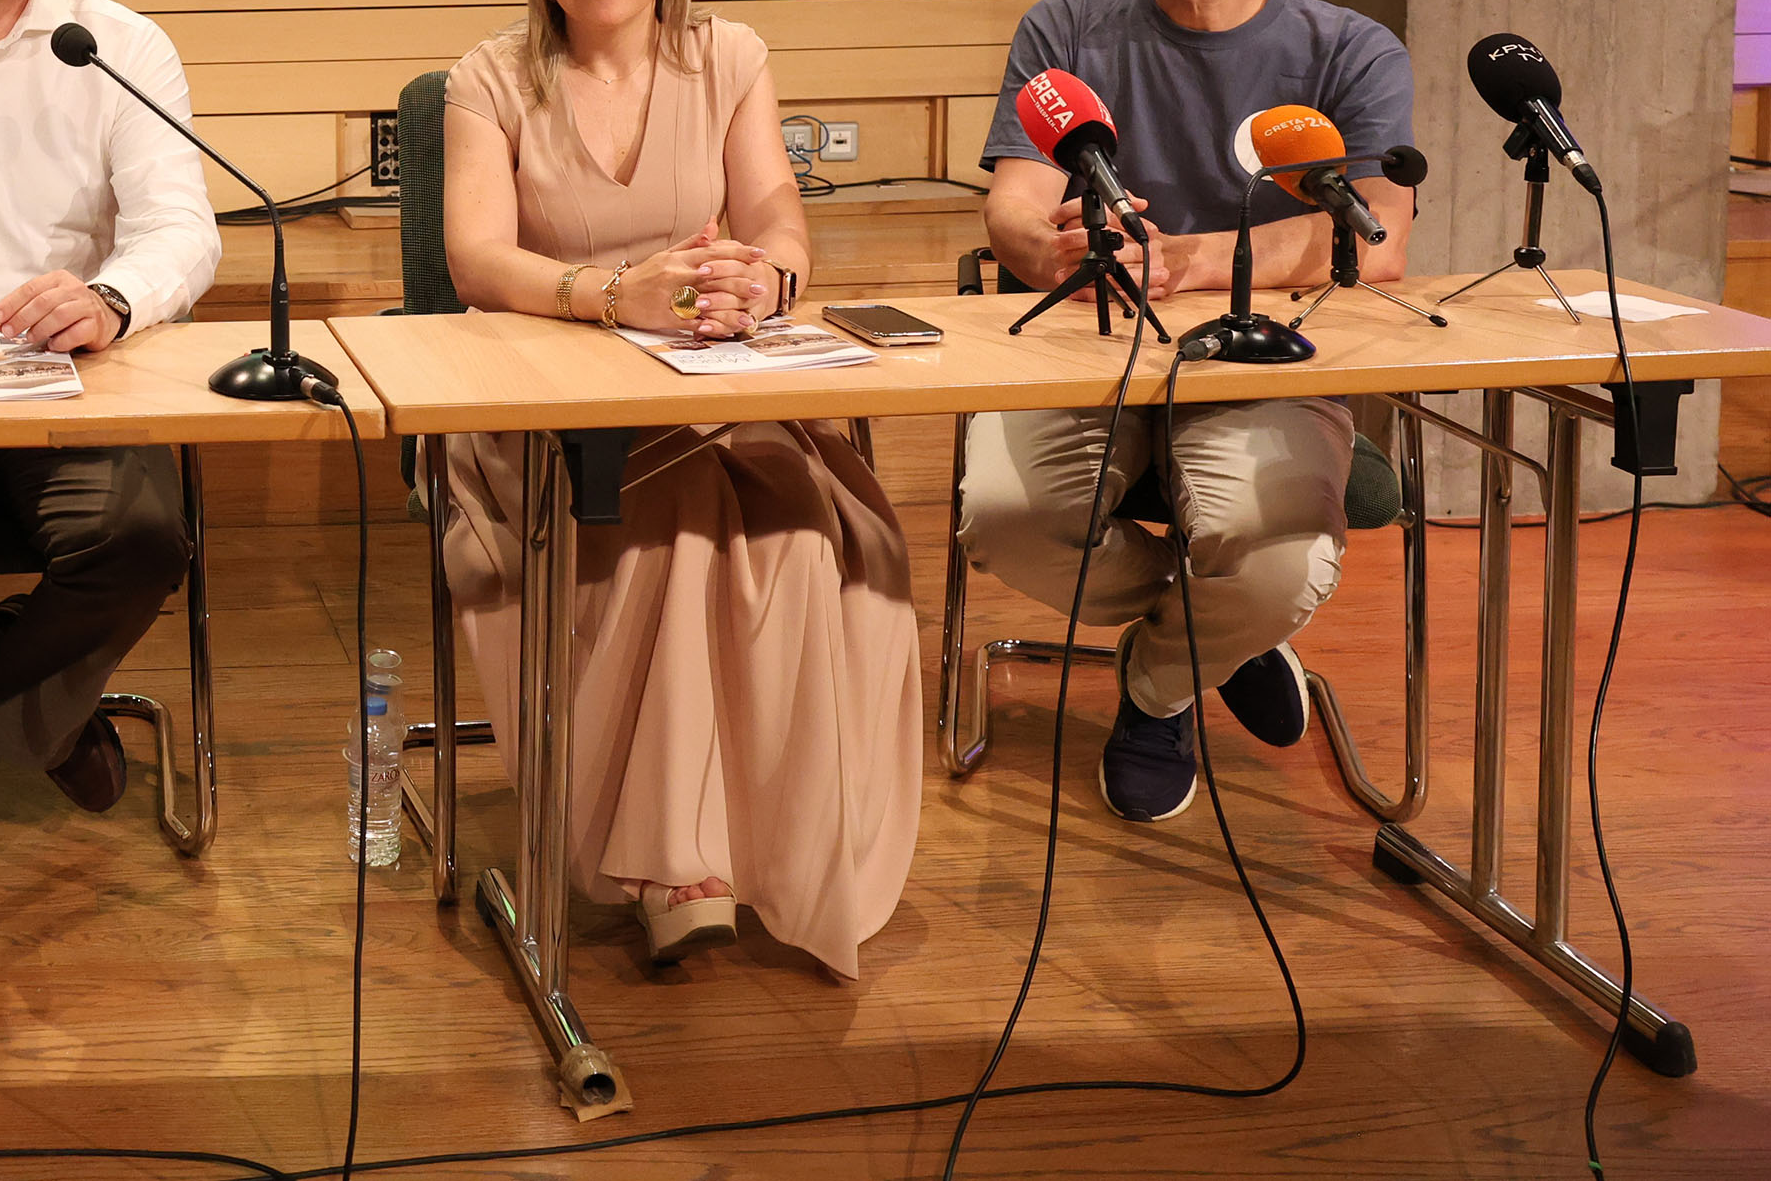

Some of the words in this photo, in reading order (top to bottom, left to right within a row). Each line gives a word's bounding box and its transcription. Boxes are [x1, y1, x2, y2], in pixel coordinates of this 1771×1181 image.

[1029, 71, 1075, 130] CRETA
[1263, 117, 1305, 138] CRETA
[1303, 116, 1333, 130] 24
